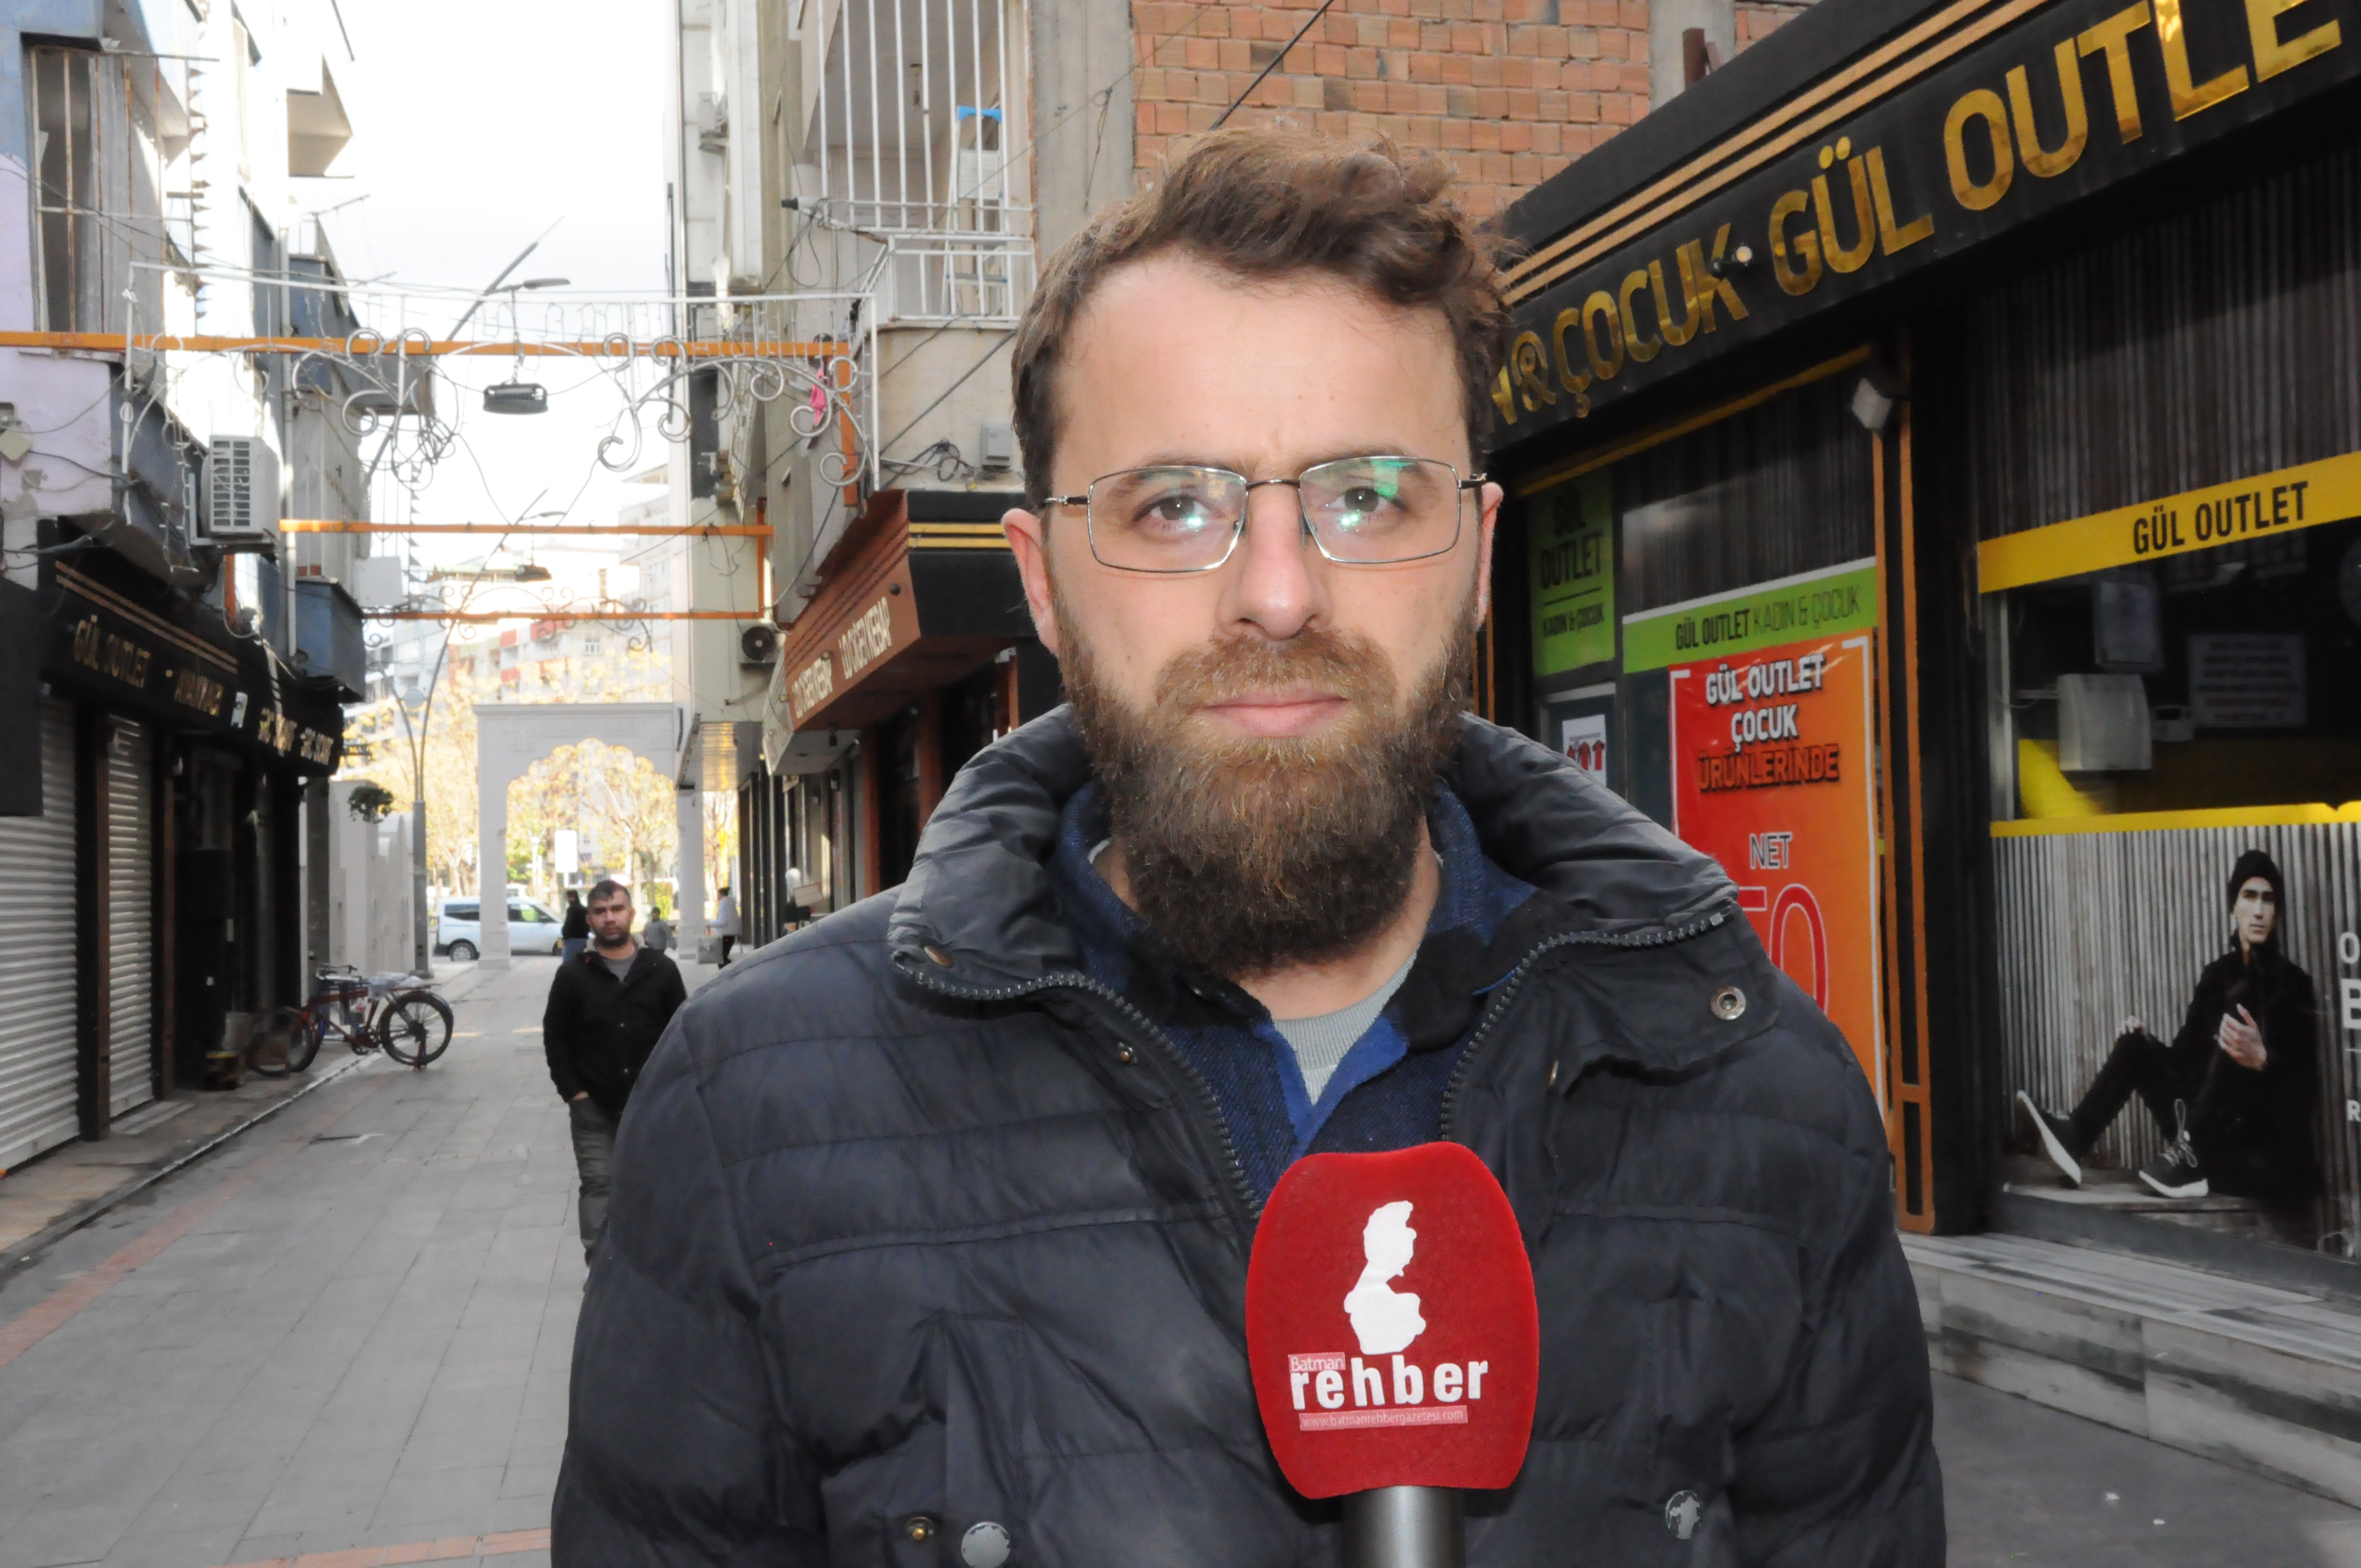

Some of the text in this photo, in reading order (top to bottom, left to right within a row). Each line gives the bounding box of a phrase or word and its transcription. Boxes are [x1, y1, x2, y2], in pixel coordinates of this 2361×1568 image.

[1553, 223, 1749, 418] ÇOCUK
[1769, 137, 1935, 296] GÜL
[2133, 481, 2308, 555] GÜL OUTLET
[1541, 530, 1604, 589] OUTLET
[1676, 617, 1699, 650] GÜL
[1702, 608, 1750, 645] OUTLET
[1753, 600, 1795, 635] KADIN
[1812, 584, 1860, 629] ÇOCUK
[1706, 653, 1825, 705] GÜL OUTLET
[1731, 704, 1798, 753] ÇOCUK
[1749, 831, 1793, 870] NET
[1737, 883, 1829, 1019] 0
[1290, 1355, 1488, 1409] rehber
[1291, 1356, 1344, 1372] Batman
[1302, 1410, 1464, 1428] www.batmanrehbergazetesi.com
